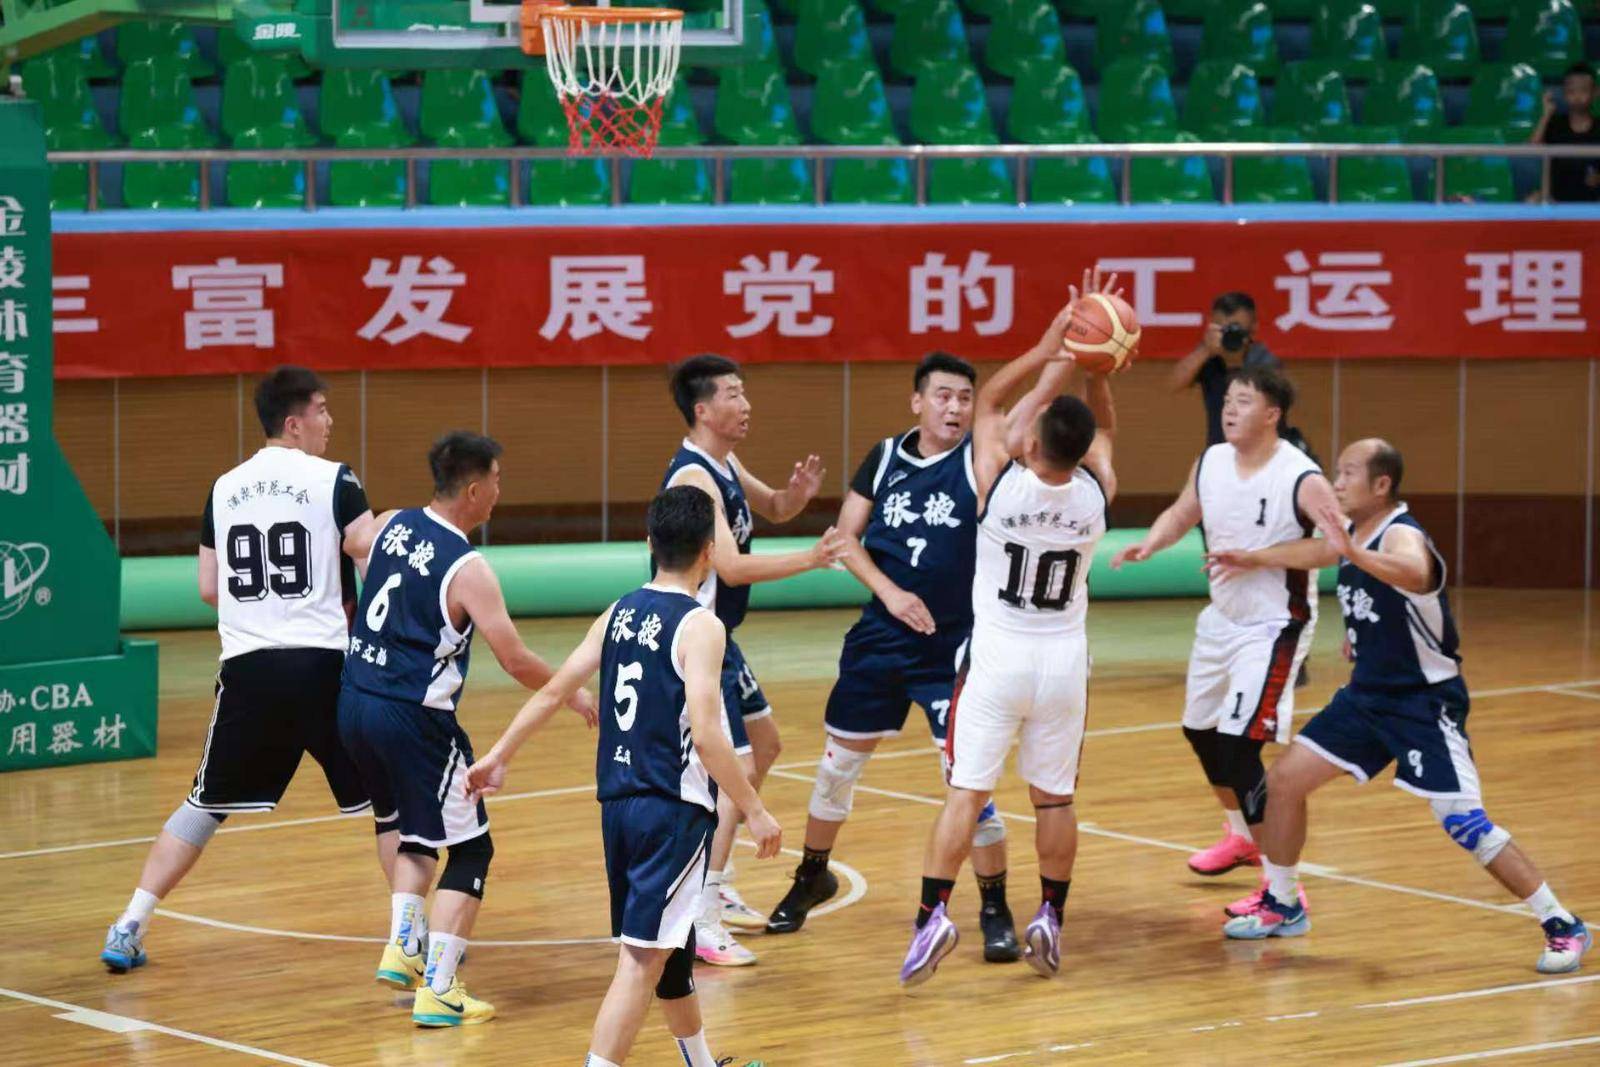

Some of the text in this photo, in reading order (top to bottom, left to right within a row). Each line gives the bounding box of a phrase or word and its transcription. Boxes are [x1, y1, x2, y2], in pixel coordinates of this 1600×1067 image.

[882, 490, 962, 529] 张掖
[1255, 498, 1267, 527] 1
[226, 520, 314, 603] 99
[381, 523, 436, 577] 张掖
[906, 536, 928, 568] 7
[998, 541, 1082, 611] 10
[365, 572, 402, 632] 6
[611, 608, 663, 652] 张掖
[614, 661, 644, 732] 5
[931, 699, 950, 727] 7
[1230, 692, 1243, 720] 1
[1407, 749, 1424, 779] 9
